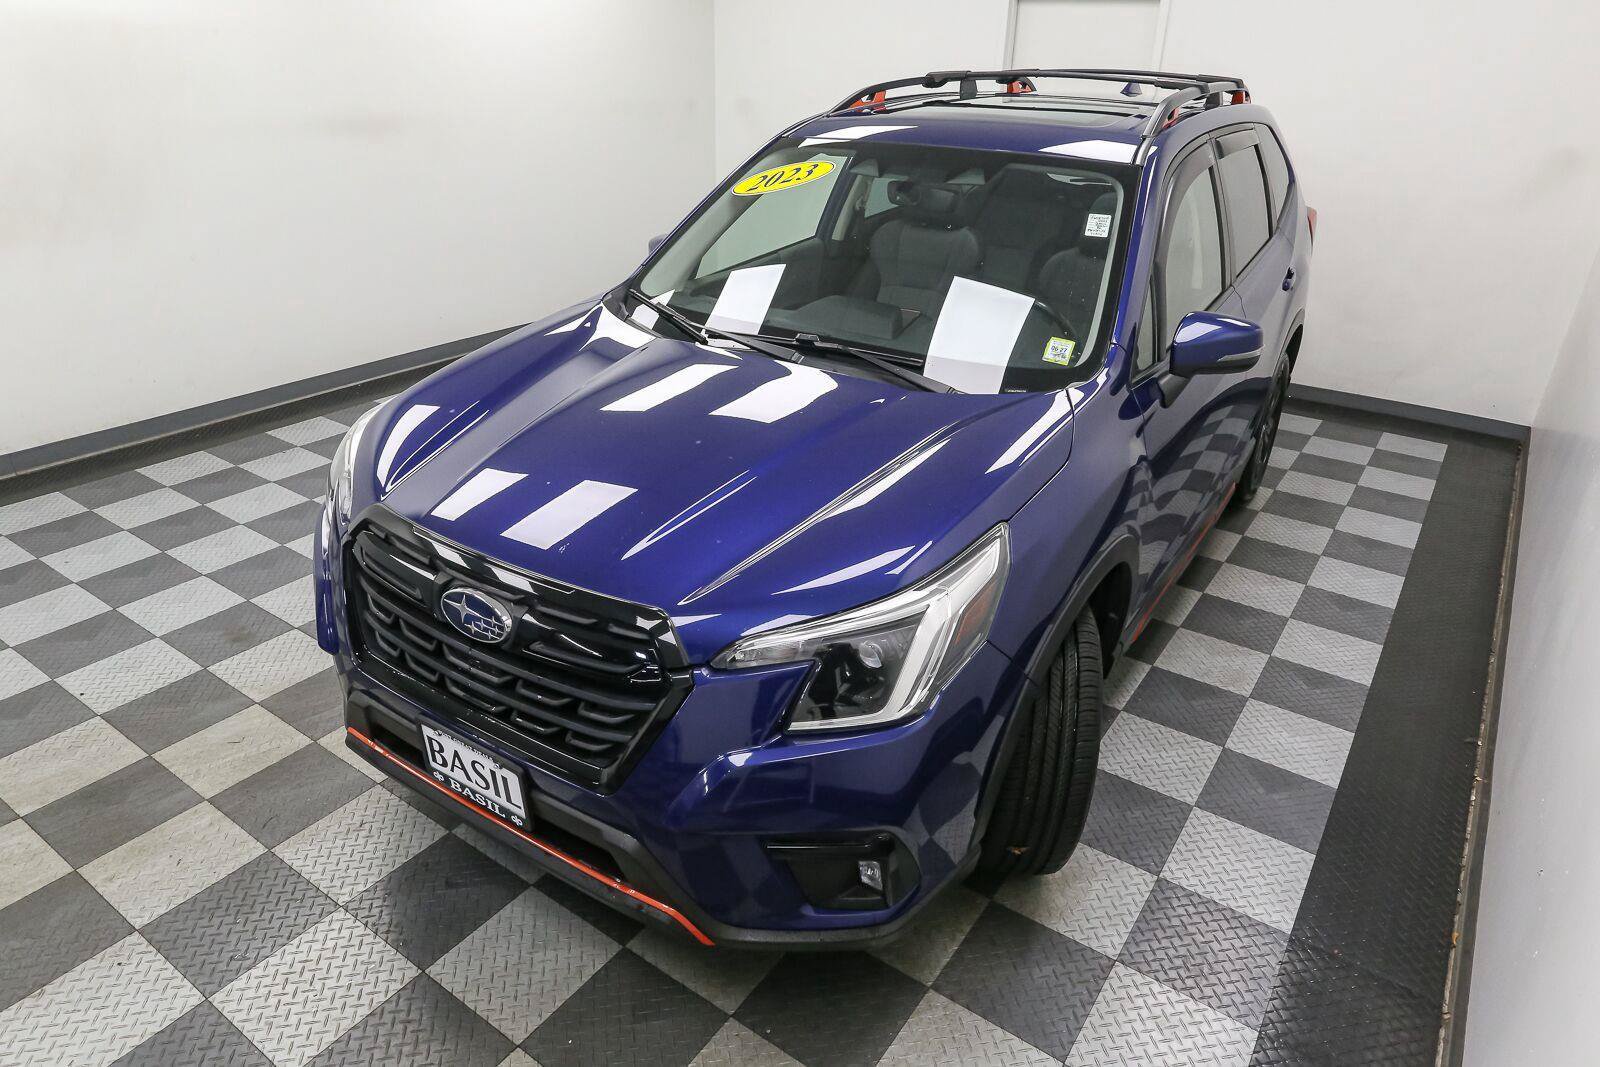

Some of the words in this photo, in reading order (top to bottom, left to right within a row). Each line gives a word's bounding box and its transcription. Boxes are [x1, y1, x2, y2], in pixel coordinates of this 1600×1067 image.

[745, 164, 819, 192] 2023
[426, 734, 522, 810] BASIL
[448, 777, 506, 819] BASIL
